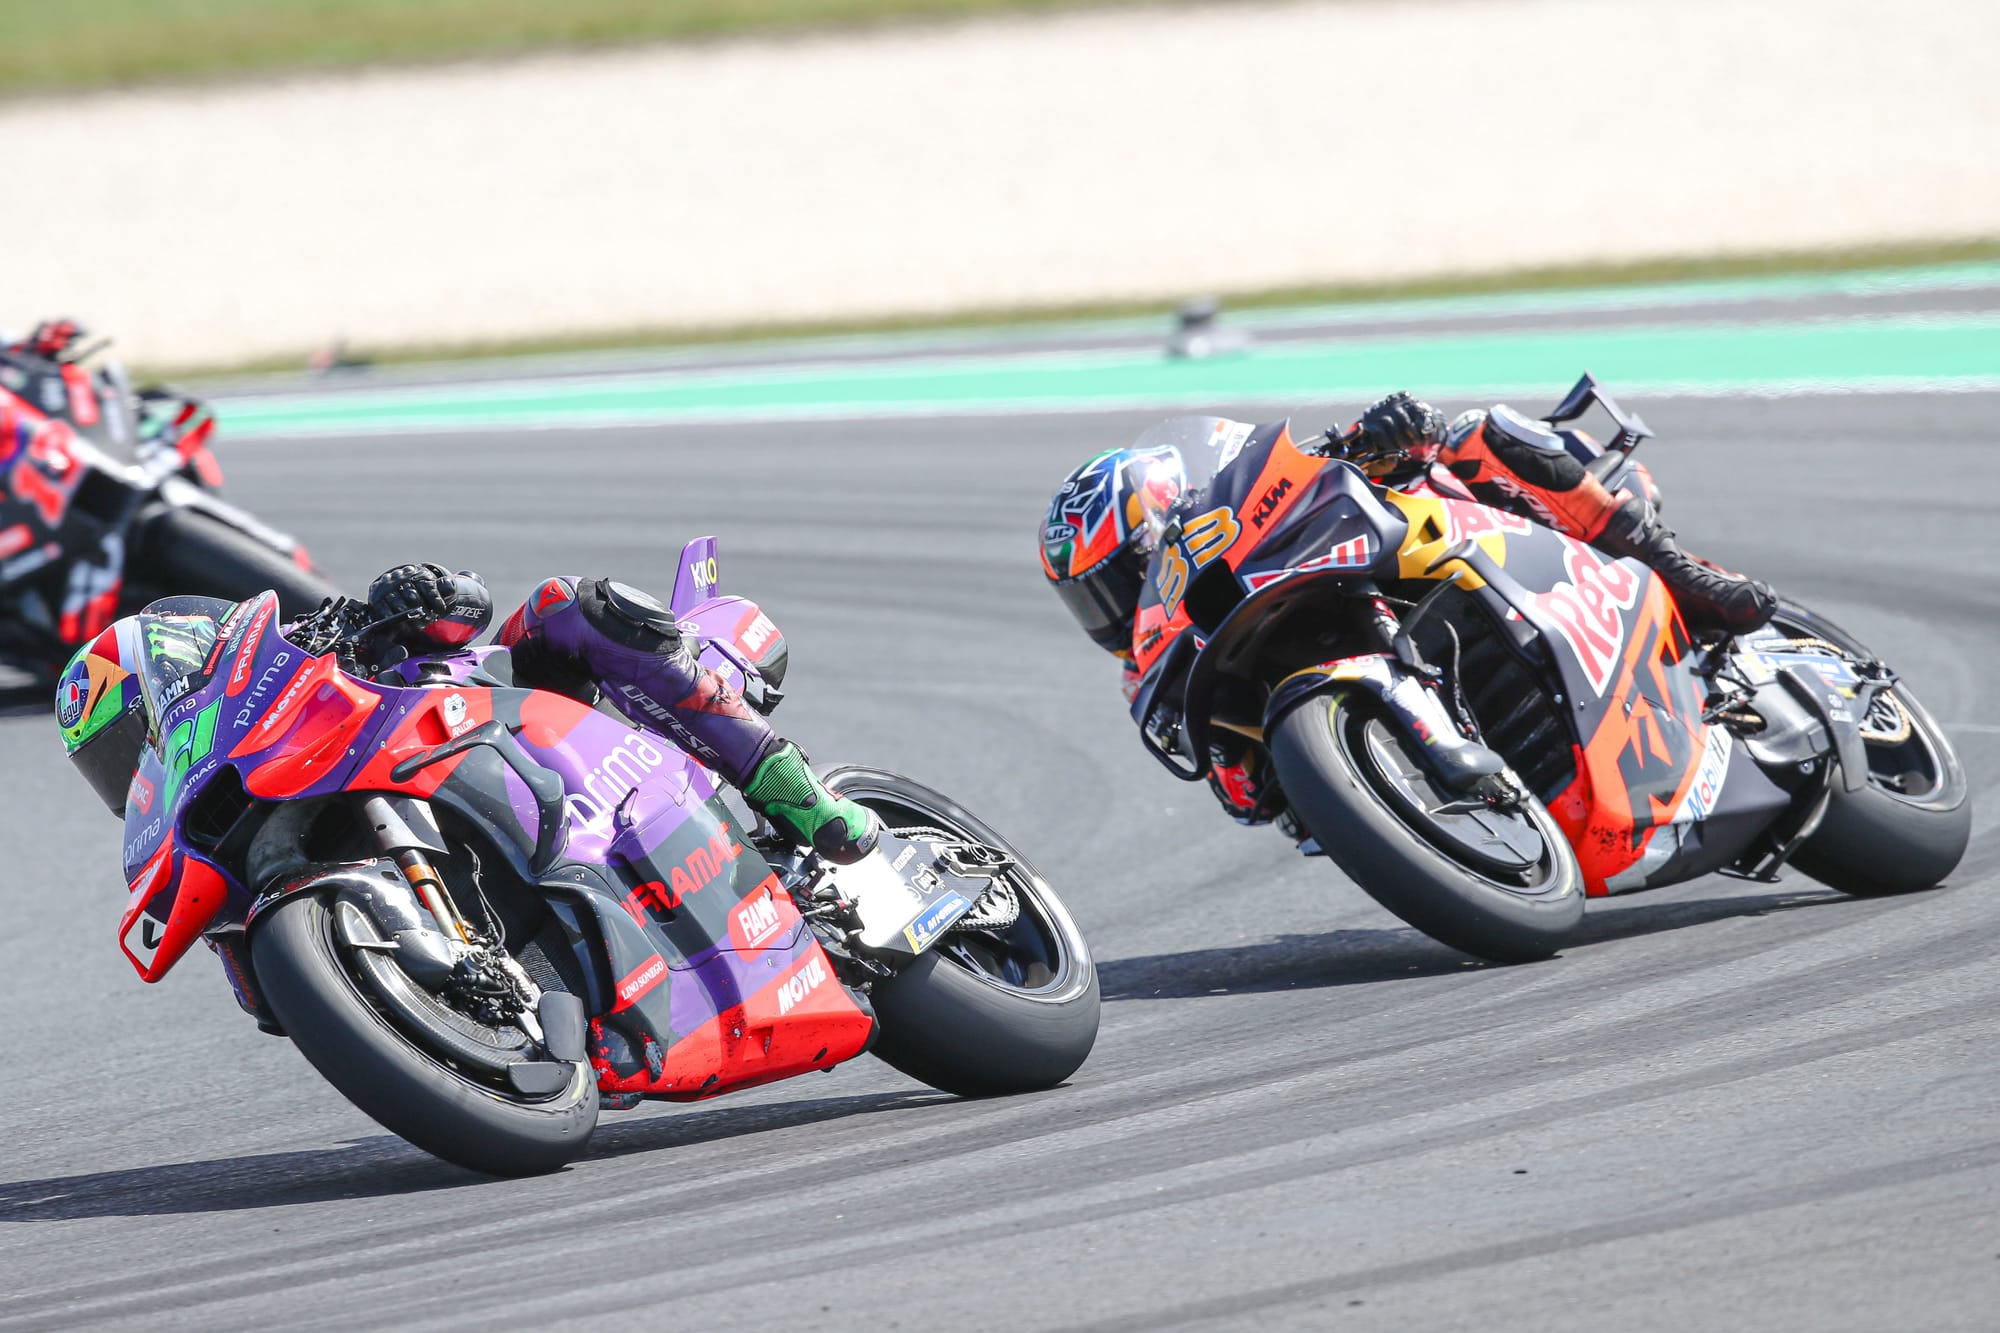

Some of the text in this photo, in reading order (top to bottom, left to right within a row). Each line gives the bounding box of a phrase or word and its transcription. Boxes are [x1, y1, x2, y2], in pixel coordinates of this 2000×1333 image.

[1251, 477, 1294, 530] KTM
[690, 557, 718, 590] KILO
[1156, 506, 1242, 622] 33
[233, 606, 273, 684] PRAMAC
[741, 611, 778, 653] MOTU
[1532, 530, 1640, 696] Red
[233, 651, 291, 729] prima
[262, 665, 316, 731] MOTUL
[620, 684, 721, 759] DAINESE
[564, 733, 664, 842] prima
[620, 821, 744, 929] PRAMAC
[738, 890, 781, 943] FIAMM
[620, 980, 640, 1001] LINO
[777, 957, 827, 1016] MOTUL
